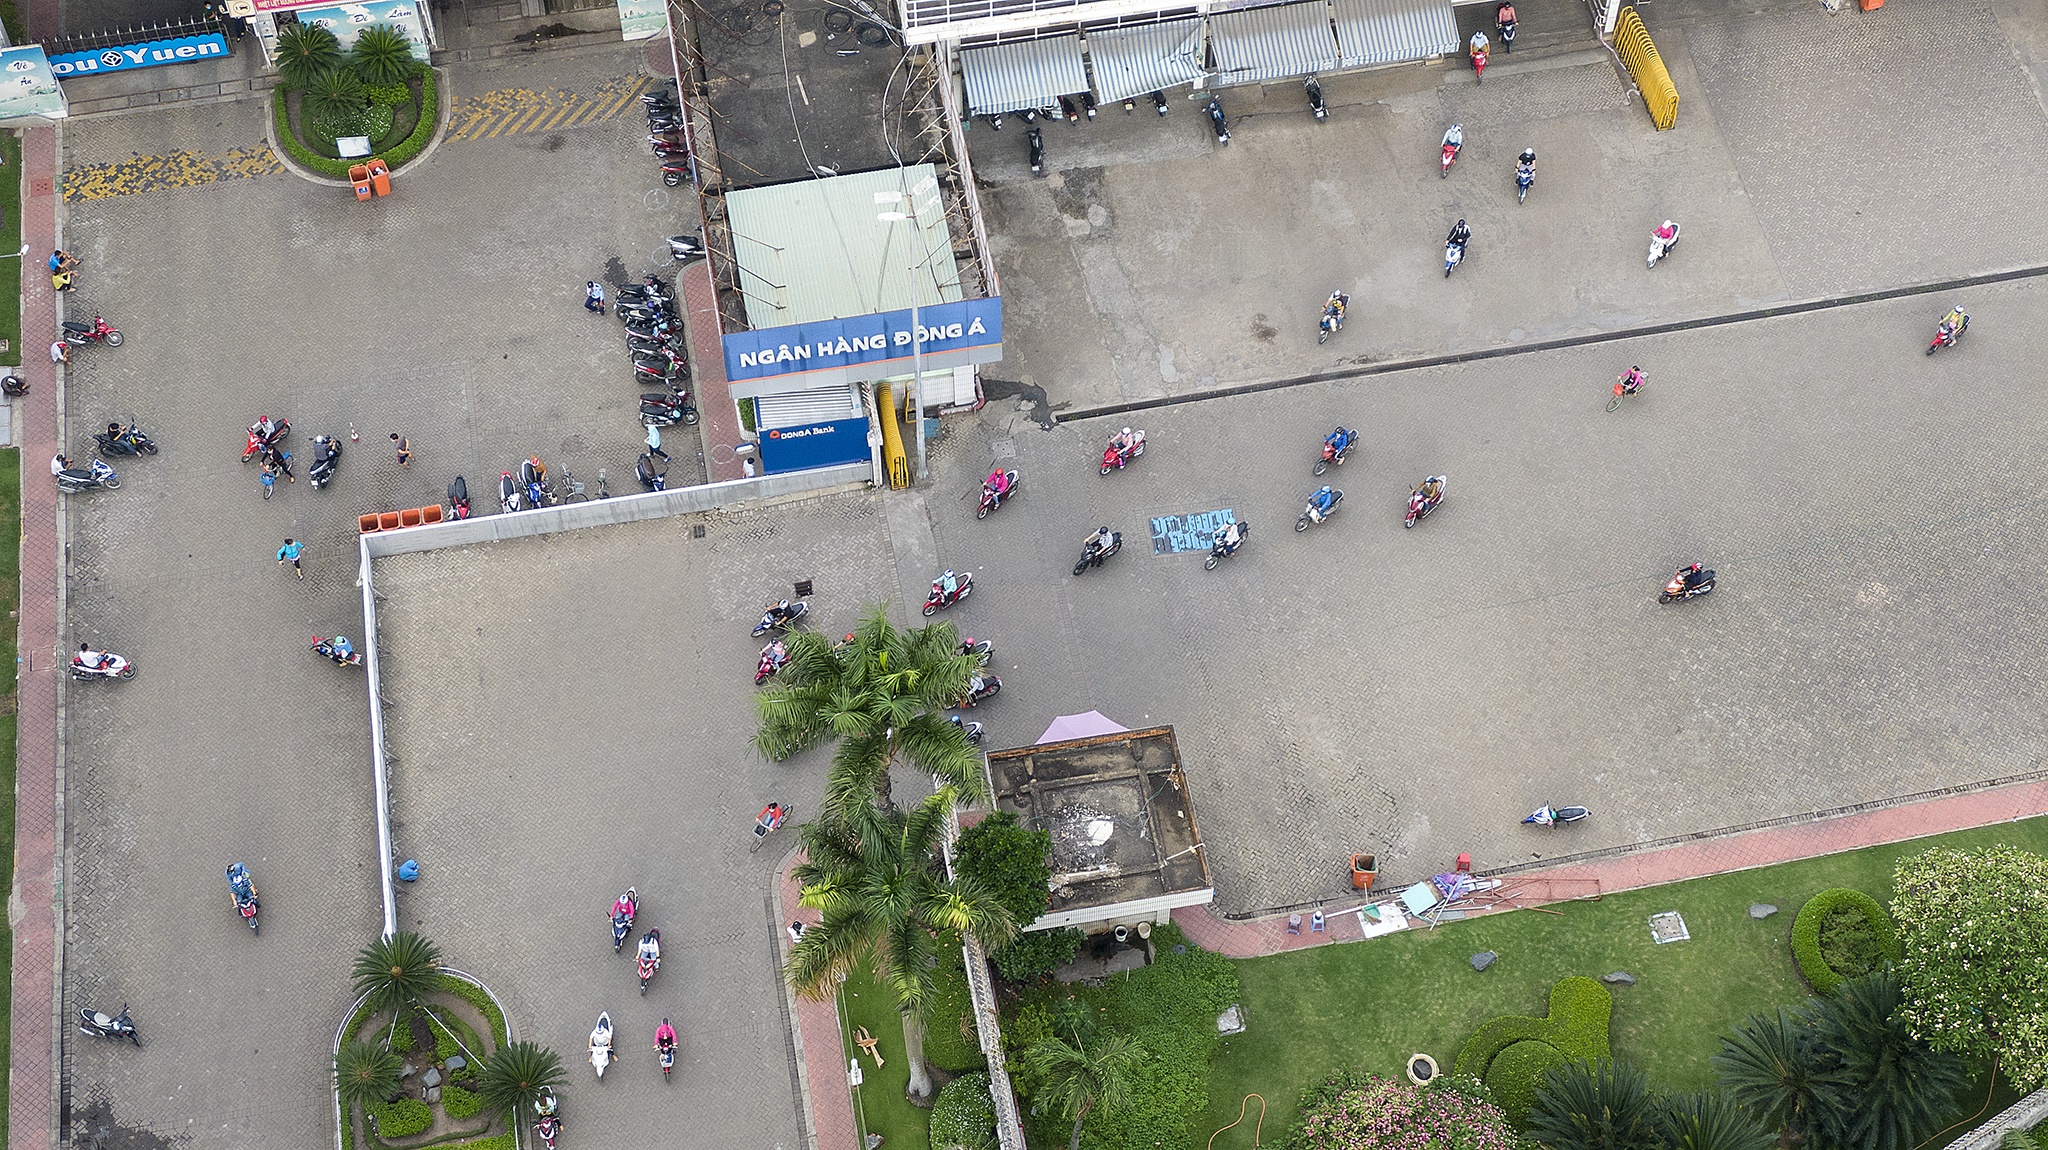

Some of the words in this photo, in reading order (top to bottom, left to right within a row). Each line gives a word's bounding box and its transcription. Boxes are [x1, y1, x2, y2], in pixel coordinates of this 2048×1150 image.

[53, 58, 99, 75] ou
[122, 42, 221, 65] Yuen
[740, 343, 812, 368] NGÂN
[817, 333, 887, 357] HÀNG
[893, 322, 963, 346] ĐÔNG
[968, 316, 987, 336] Á
[812, 425, 835, 436] Bank
